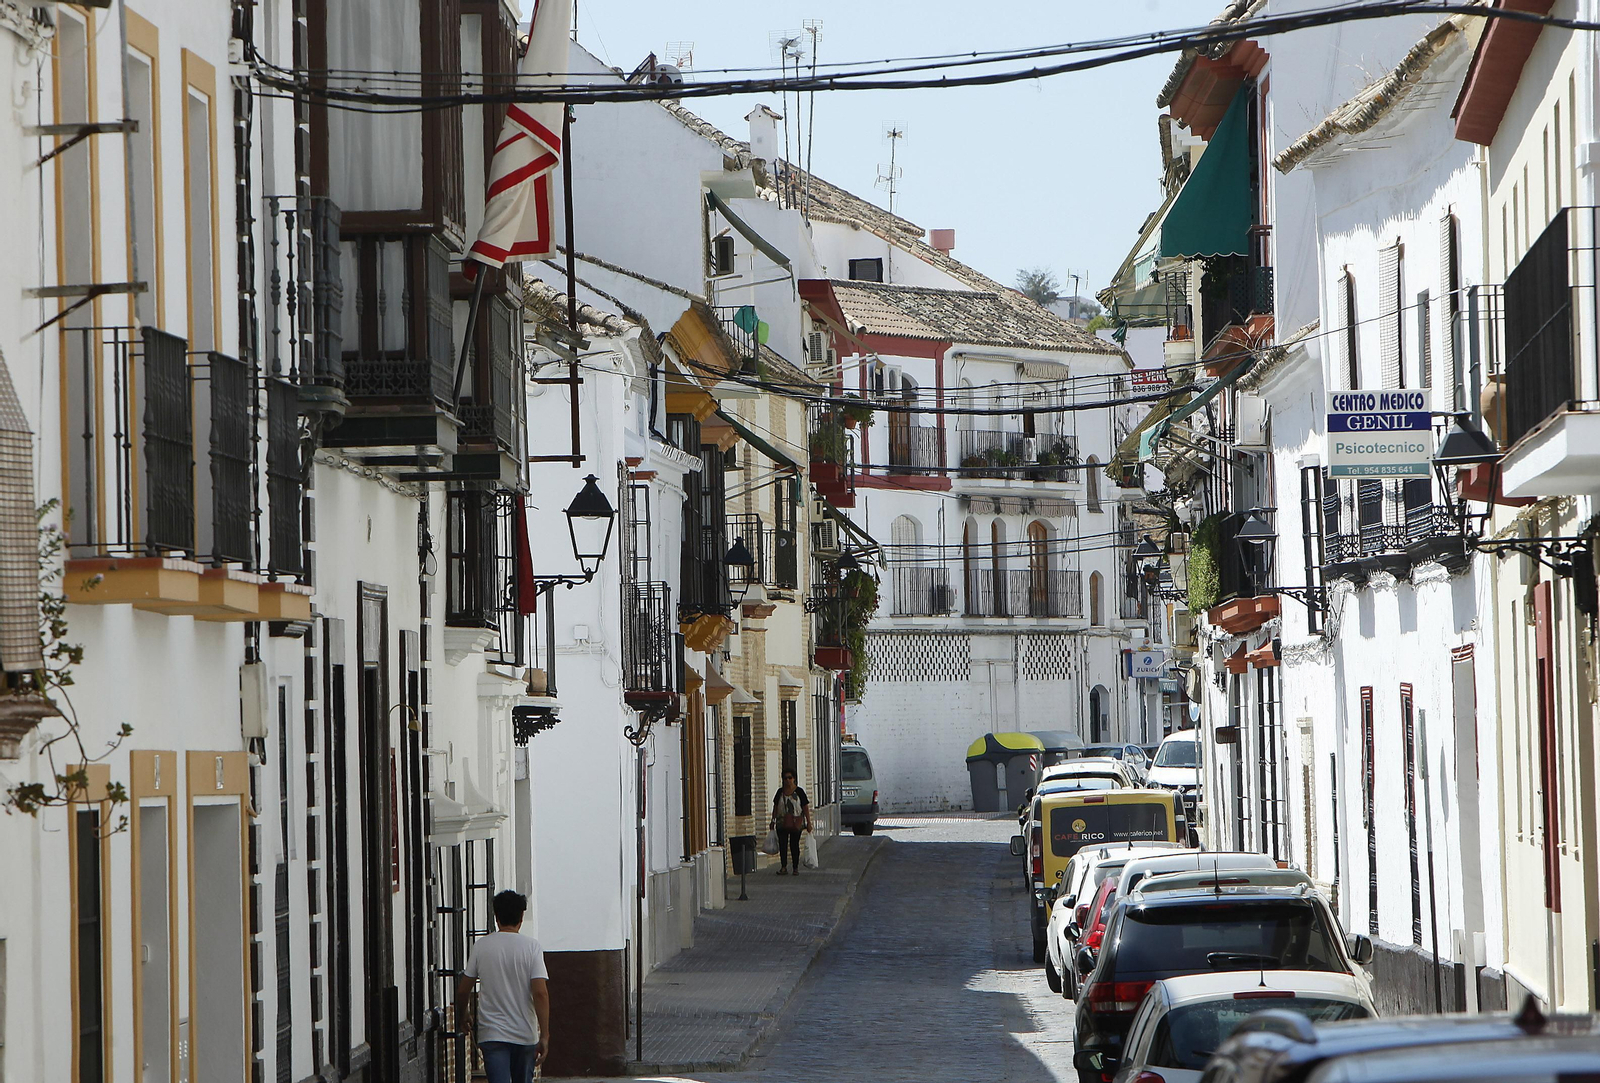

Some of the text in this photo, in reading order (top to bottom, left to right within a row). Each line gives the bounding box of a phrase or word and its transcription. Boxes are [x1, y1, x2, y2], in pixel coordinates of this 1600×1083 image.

[1332, 392, 1425, 412] CENTRO MEDICO
[1346, 414, 1413, 431] GENIL
[1336, 441, 1425, 454] Psicotecnico
[1347, 465, 1413, 475] Tel. 954 835 641
[1081, 832, 1105, 840] RICO
